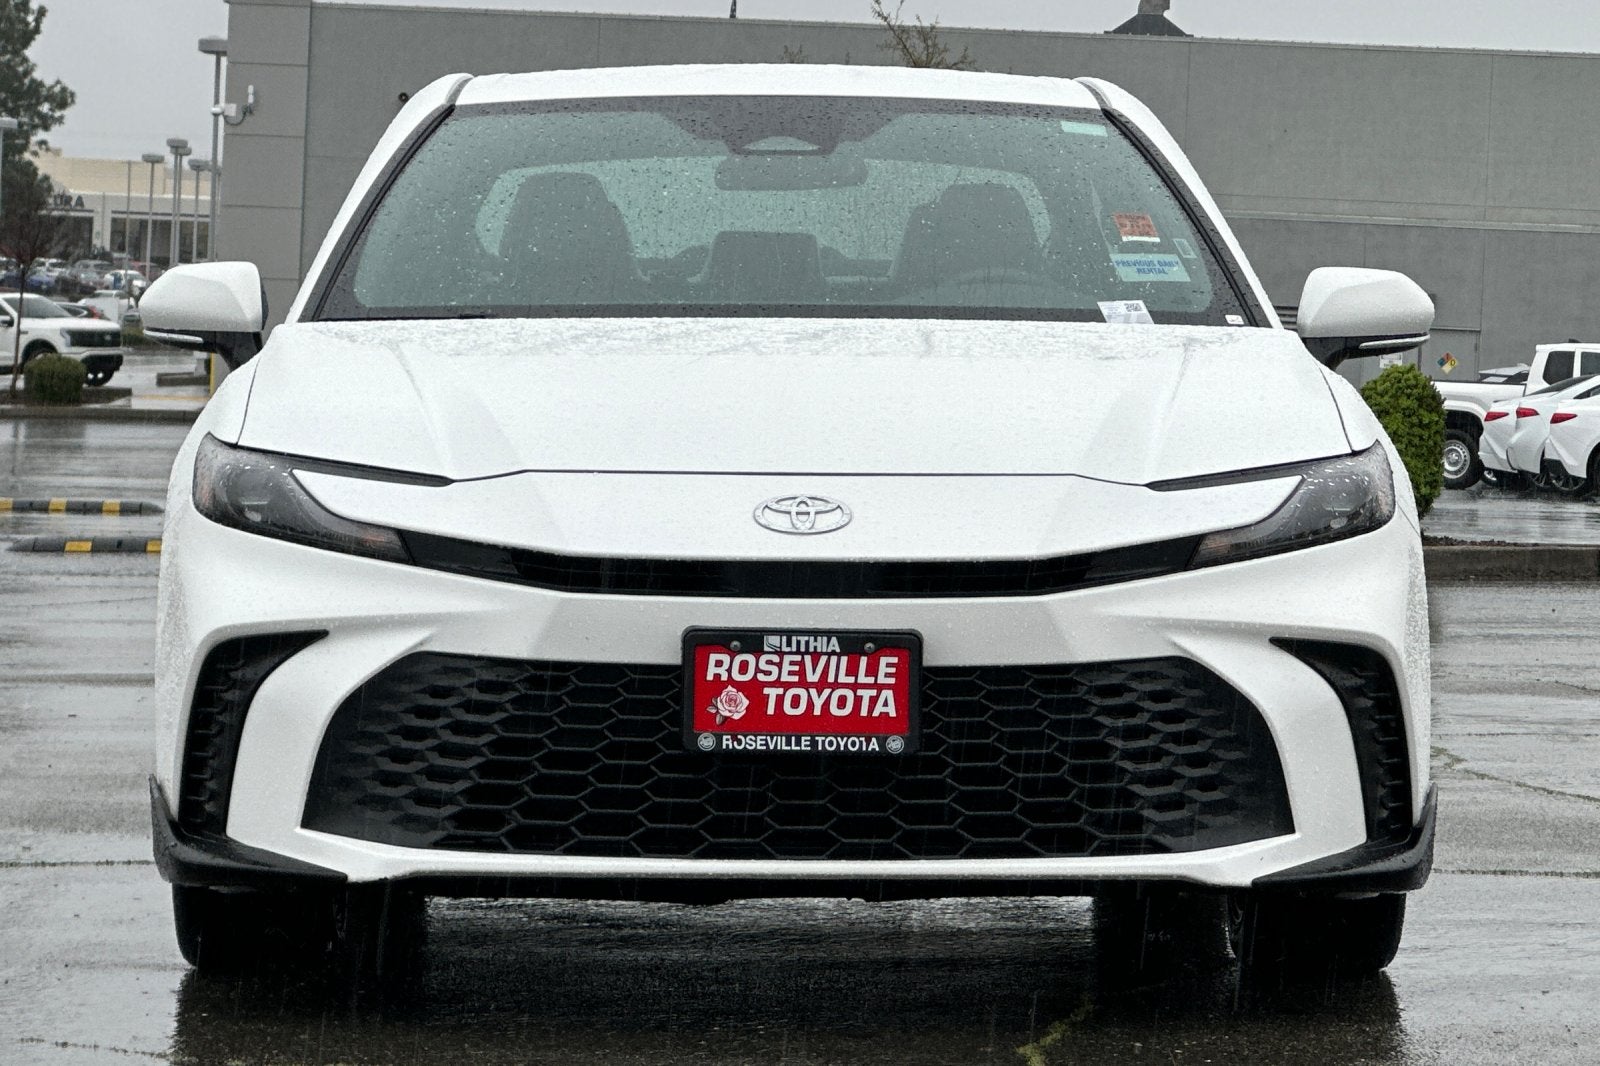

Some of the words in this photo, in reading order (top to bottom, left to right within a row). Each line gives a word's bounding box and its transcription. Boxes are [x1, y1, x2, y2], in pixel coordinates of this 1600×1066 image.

[1136, 267, 1169, 275] RENTAL
[782, 636, 840, 653] LITHIA
[706, 654, 898, 683] ROSEVILLE
[763, 688, 896, 716] TOYOTA
[722, 735, 811, 750] ROSEVILLE
[815, 736, 879, 751] TOYOTA
